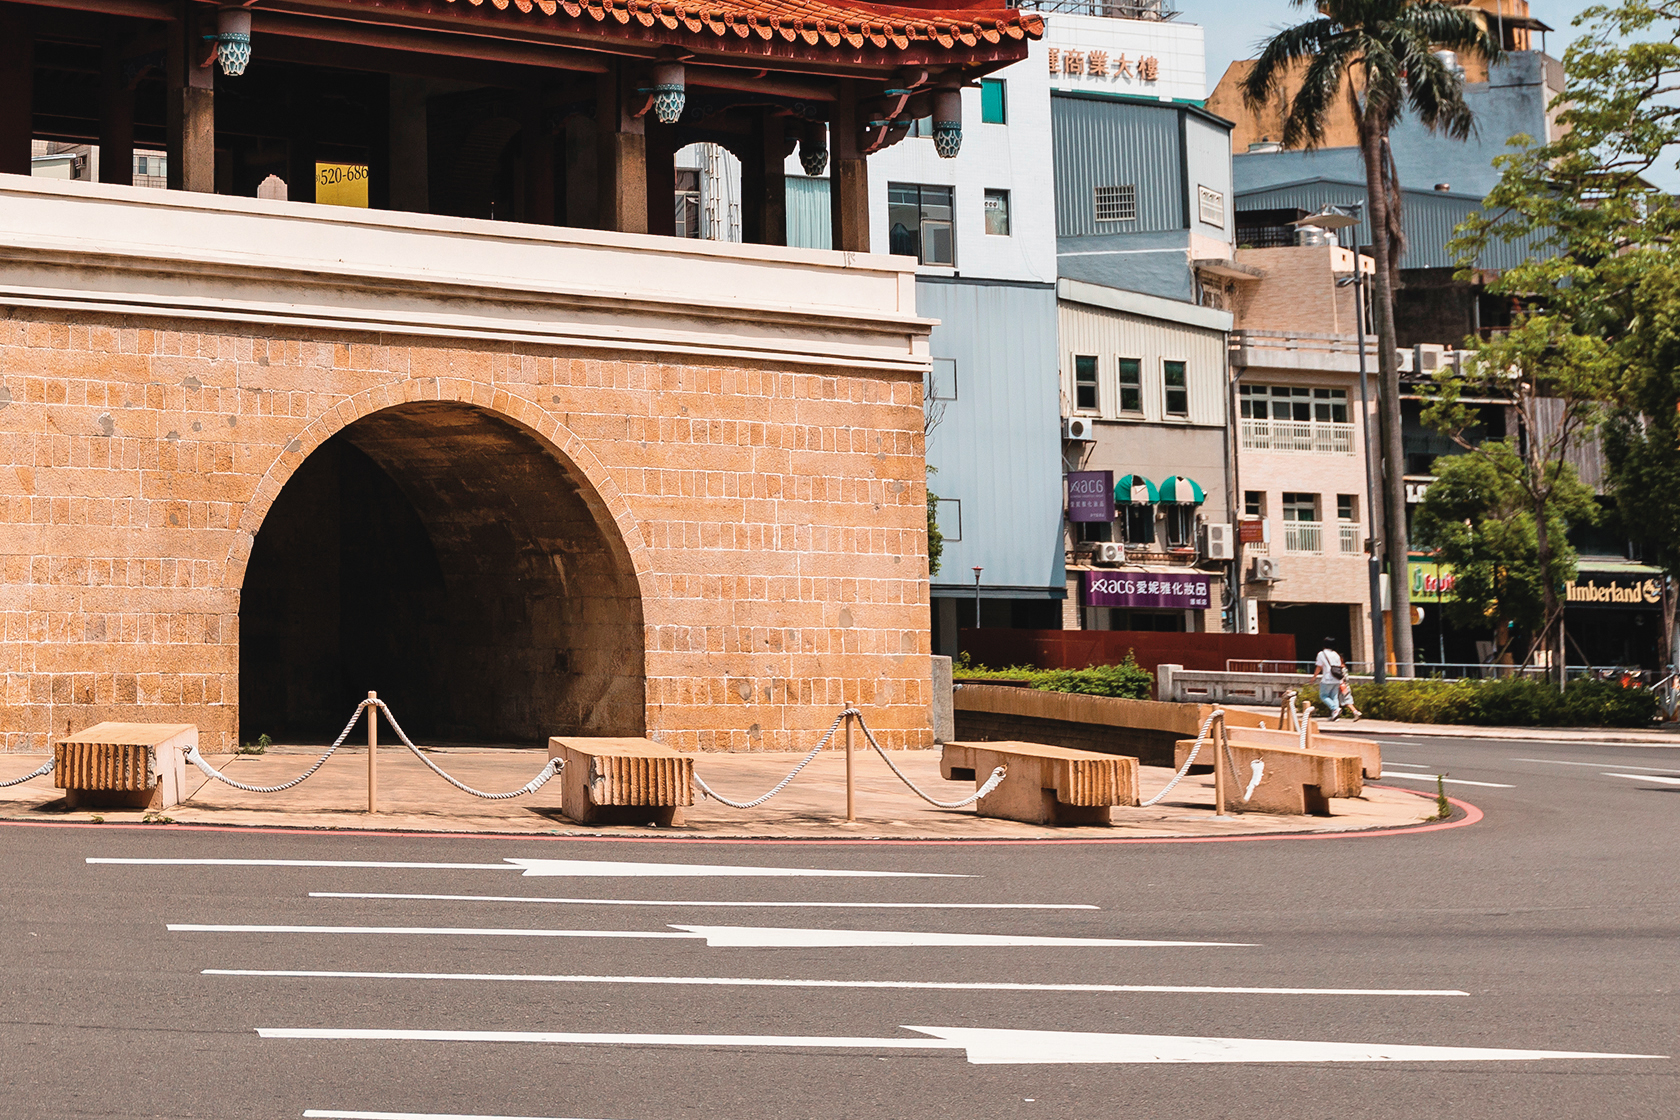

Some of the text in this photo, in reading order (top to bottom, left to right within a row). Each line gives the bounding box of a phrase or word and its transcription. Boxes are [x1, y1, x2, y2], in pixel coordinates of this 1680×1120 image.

[1136, 580, 1207, 596] 愛妮雅化妝品
